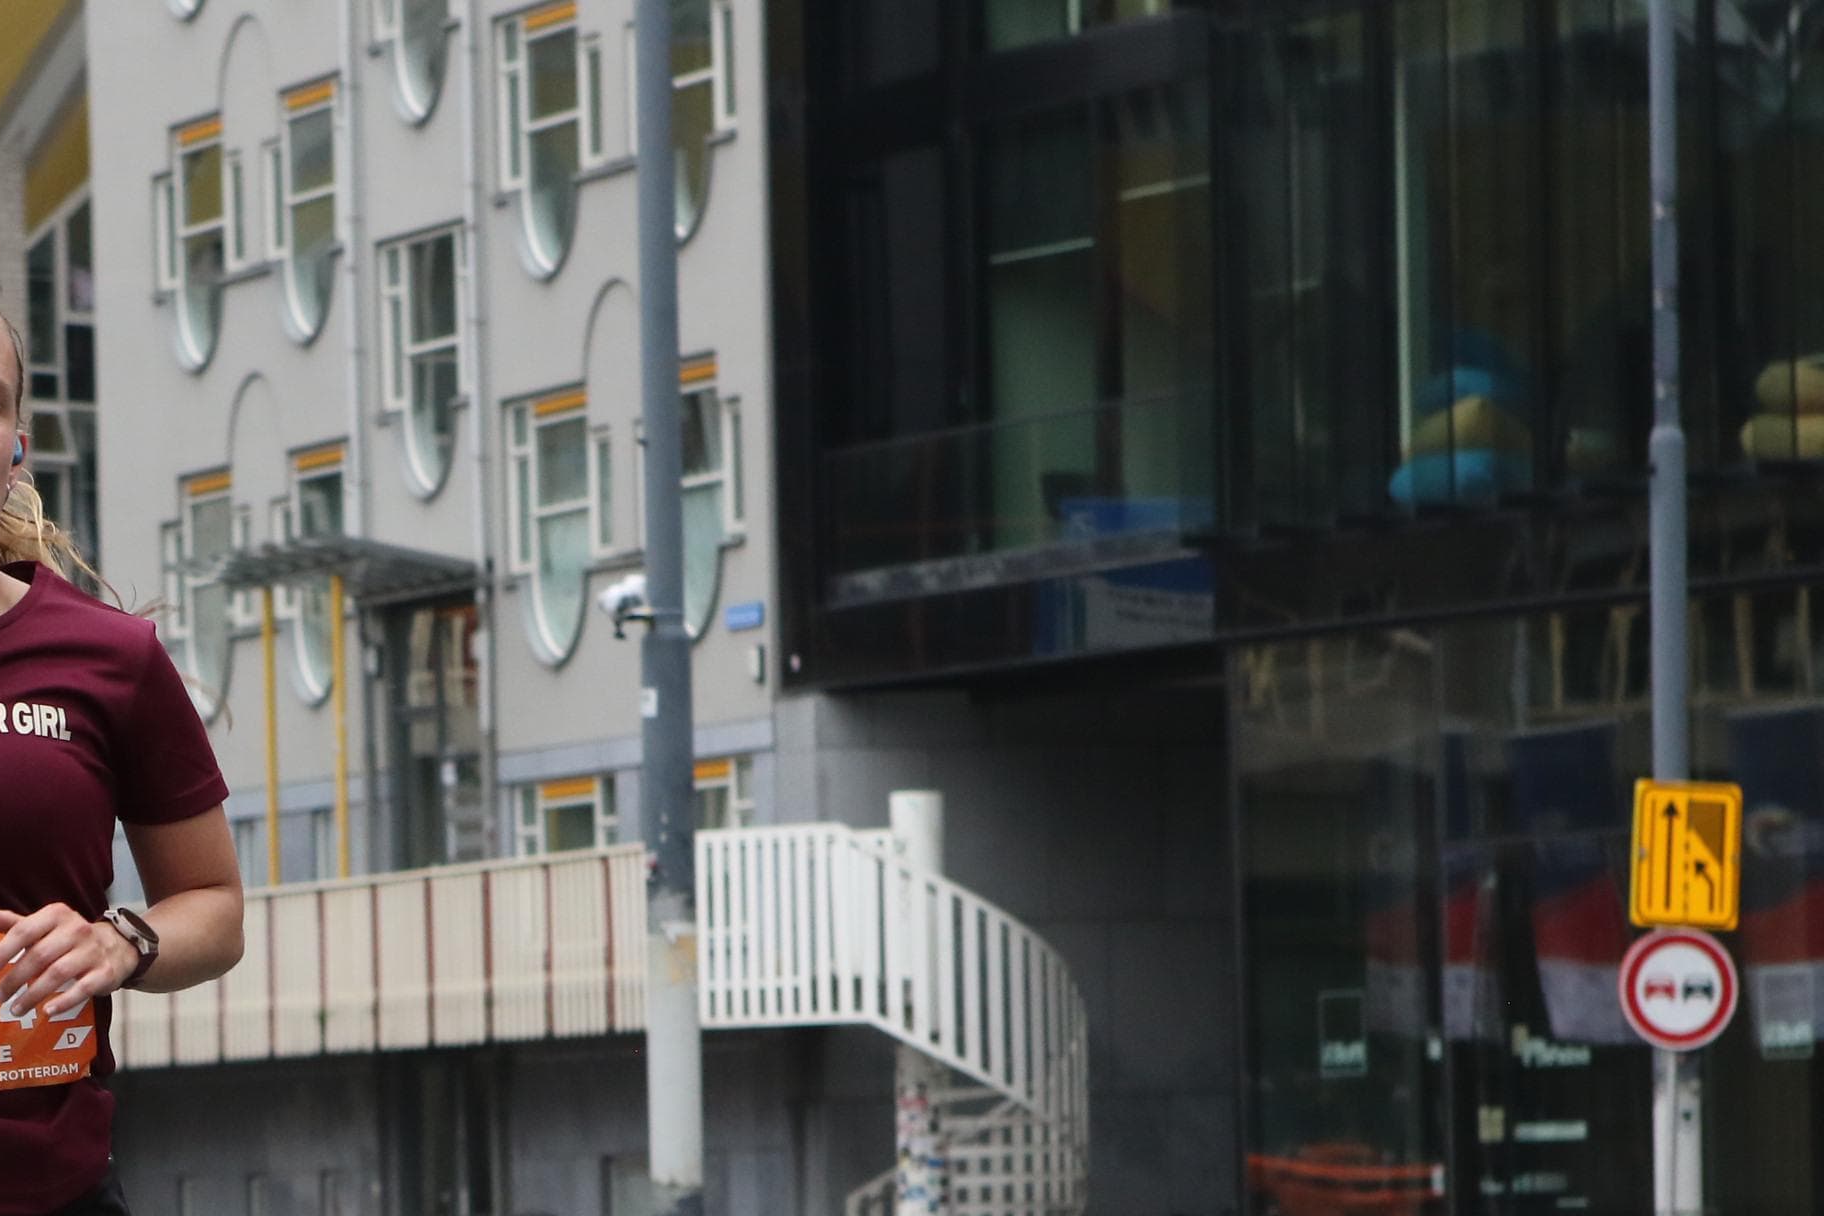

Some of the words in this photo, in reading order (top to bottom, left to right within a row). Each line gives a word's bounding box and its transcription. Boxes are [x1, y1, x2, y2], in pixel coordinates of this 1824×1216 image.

[12, 703, 73, 742] GIRL
[66, 1033, 77, 1044] D
[0, 1063, 79, 1082] ROTTERDAM
